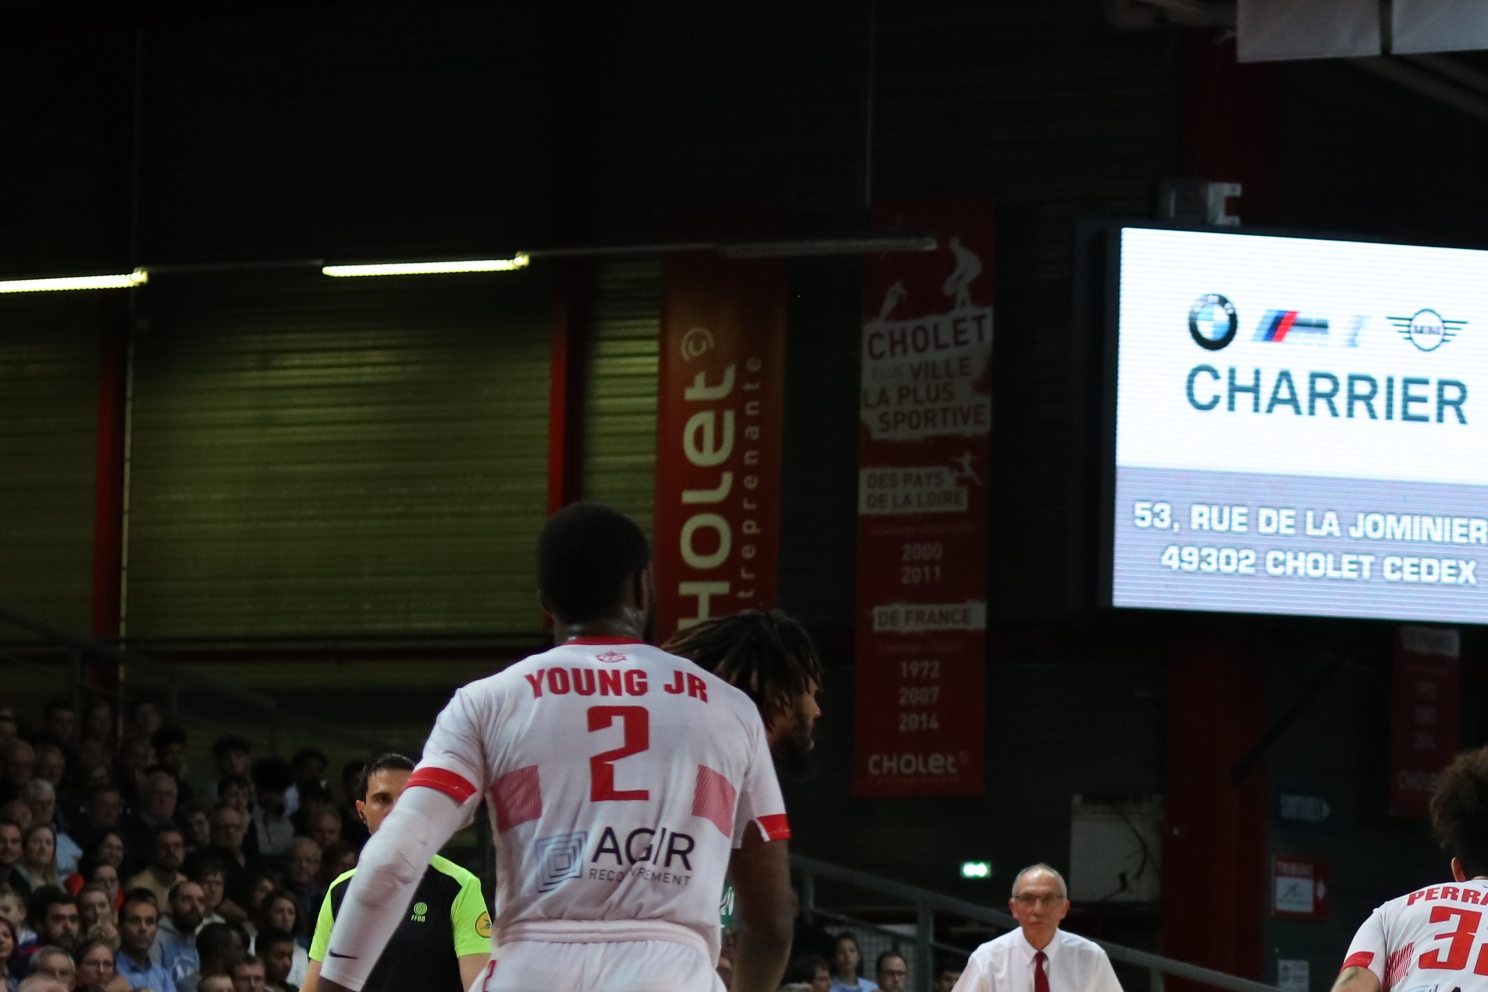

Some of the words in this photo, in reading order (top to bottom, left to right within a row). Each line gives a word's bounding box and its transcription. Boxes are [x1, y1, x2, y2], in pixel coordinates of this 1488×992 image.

[868, 314, 987, 360] CHOLET
[910, 356, 970, 380] VILLE
[863, 387, 889, 409] LA
[898, 382, 954, 406] PLUS
[1186, 364, 1469, 425] CHARRIER
[878, 403, 986, 432] SPORTIVE
[867, 472, 898, 489] DES
[903, 471, 944, 488] PAYS
[866, 493, 887, 509] DE
[1133, 501, 1180, 533] 53,
[1190, 504, 1248, 533] RUE
[1257, 507, 1297, 535] DE
[1305, 510, 1341, 538] LA
[1160, 545, 1256, 575] 49302
[1265, 549, 1375, 581] CHOLET
[1382, 555, 1478, 586] CEDEX
[878, 609, 899, 626] DE
[905, 608, 972, 625] FRANCE
[524, 667, 649, 699] YOUNG
[663, 670, 708, 704] JR
[586, 705, 649, 802] 2
[591, 826, 695, 871] AGIR
